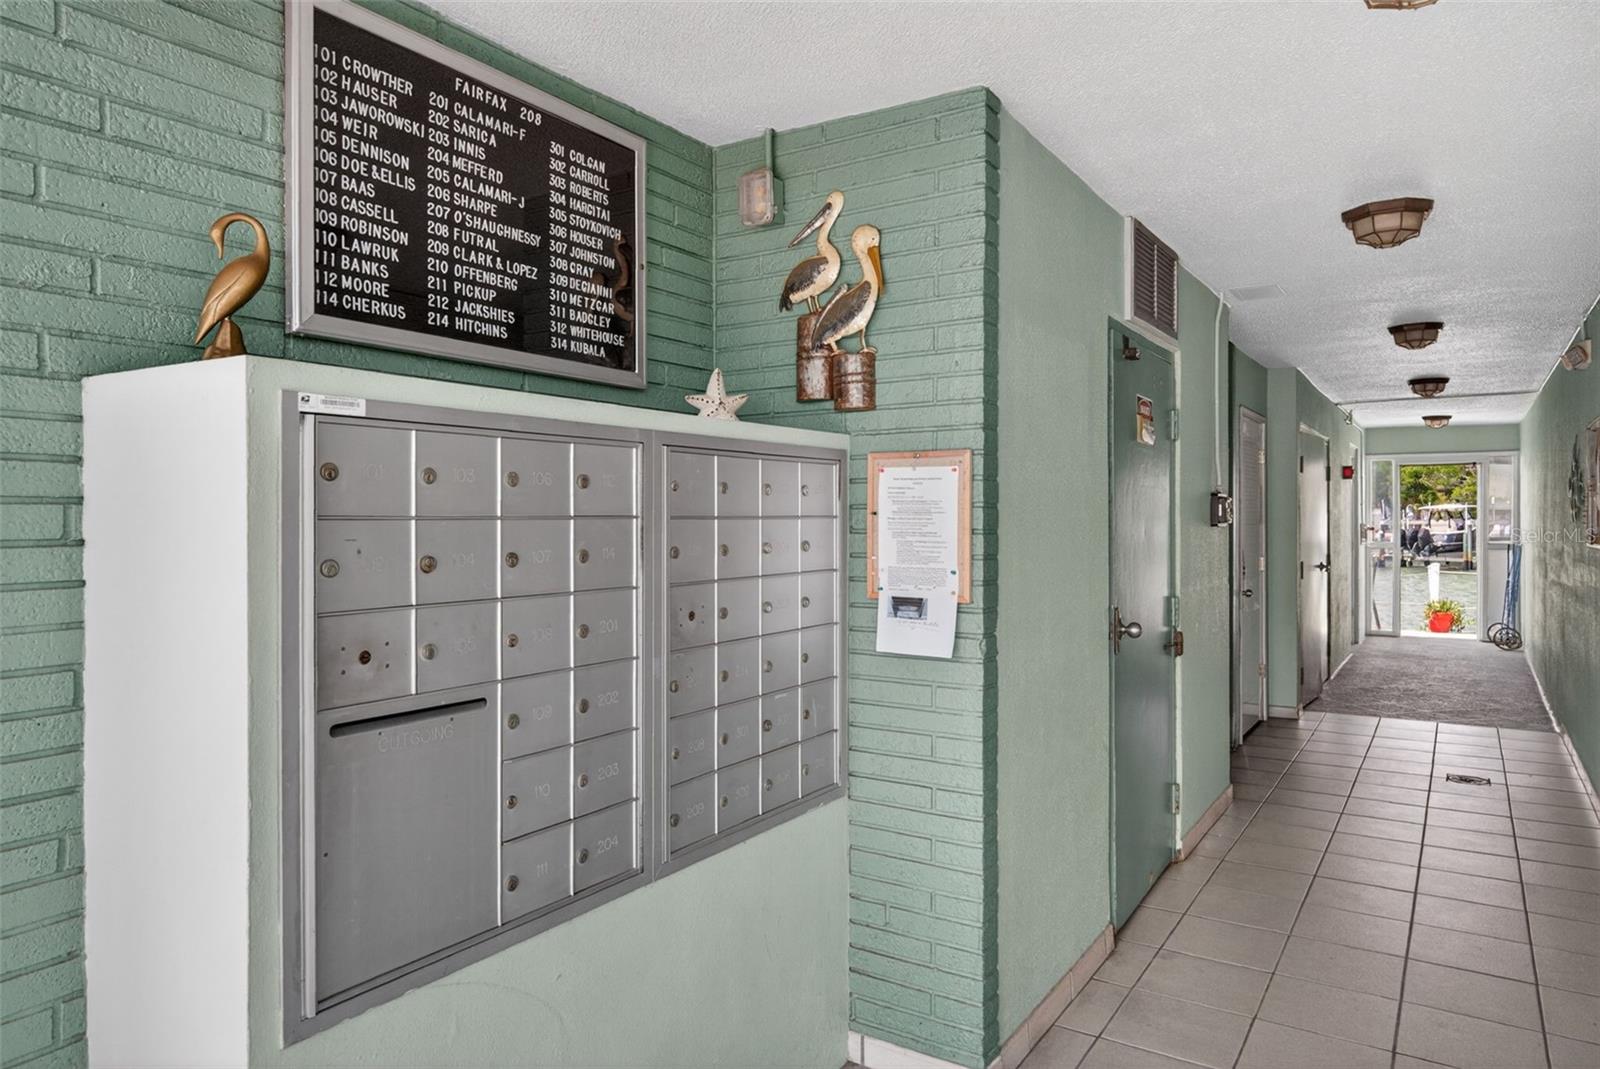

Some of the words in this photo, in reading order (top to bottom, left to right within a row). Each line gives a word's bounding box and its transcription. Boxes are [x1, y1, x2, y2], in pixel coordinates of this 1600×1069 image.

[315, 43, 336, 66] 101
[342, 55, 413, 97] CROWTHER
[315, 64, 338, 86] 102
[341, 74, 398, 109] HAUSER
[429, 91, 449, 111] 201
[455, 77, 507, 112] FAIRFAX
[520, 106, 542, 126] 208
[315, 84, 338, 105] 103
[341, 95, 425, 138] JAWOROWSKI
[315, 105, 338, 126] 104
[341, 115, 378, 140] WEIR
[428, 109, 450, 129] 202
[453, 119, 497, 148] SARICA
[428, 127, 450, 147] 203
[453, 136, 486, 160] INNIS
[315, 125, 337, 146] 105
[341, 135, 410, 171] DENNISON
[315, 146, 337, 166] 106
[341, 155, 369, 177] DOE
[549, 140, 565, 158] 301
[569, 149, 606, 174] COLGAN
[427, 146, 449, 166] 204
[452, 154, 504, 185] MEFFERD
[427, 164, 450, 184] 205
[549, 156, 567, 175] 302
[569, 165, 610, 192] CARROLL
[315, 166, 337, 186] 107
[341, 175, 375, 198] BAAS
[549, 173, 567, 190] 303
[569, 181, 609, 206] ROBERTS
[315, 187, 337, 206] 108
[341, 195, 399, 224] CASSELL
[427, 183, 450, 202] 206
[453, 191, 498, 217] SHARPE
[549, 190, 566, 207] 304
[315, 207, 337, 227] 109
[341, 215, 409, 246] ROBINSON
[427, 202, 451, 220] 207
[454, 210, 541, 248] O'SHAUGHNESSY
[427, 220, 450, 238] 208
[453, 227, 499, 253] FUTRAL
[549, 206, 568, 223] 305
[569, 213, 622, 241] STOYKOVICH
[549, 222, 568, 239] 306
[569, 229, 604, 251] HOUSER
[315, 228, 338, 247] 110
[341, 234, 399, 262] LAWRUK
[427, 238, 450, 256] 209
[453, 245, 493, 268] CLARK
[495, 257, 504, 271] &
[506, 260, 538, 280] LOPEZ
[549, 239, 568, 255] 307
[569, 246, 616, 270] JOHNSTON
[315, 248, 335, 267] 111
[341, 254, 389, 279] BANKS
[427, 257, 449, 274] 210
[454, 263, 519, 292] OFFENBERG
[549, 255, 568, 271] 308
[315, 269, 338, 287] 112
[341, 274, 390, 298] MOORE
[427, 275, 447, 292] 211
[453, 280, 497, 302] PICKUP
[549, 272, 568, 288] 309
[549, 288, 568, 303] 310
[315, 289, 338, 307] 114
[342, 294, 406, 319] CHERKUS
[427, 293, 449, 310] 212
[454, 299, 516, 325] JACKSHIES
[549, 304, 566, 319] 311
[569, 308, 611, 329] BADGLEY
[427, 311, 450, 328] 214
[455, 316, 508, 339] HITCHINS
[550, 320, 567, 335] 312
[569, 325, 625, 347] WHITEHOUSE
[550, 336, 568, 351] 314
[570, 340, 606, 358] KUBALA
[453, 464, 476, 483] 103
[599, 618, 619, 634] 201
[597, 690, 619, 707] 202
[377, 724, 454, 752] OUTGOING
[597, 762, 619, 781] 203
[597, 835, 619, 855] 204
